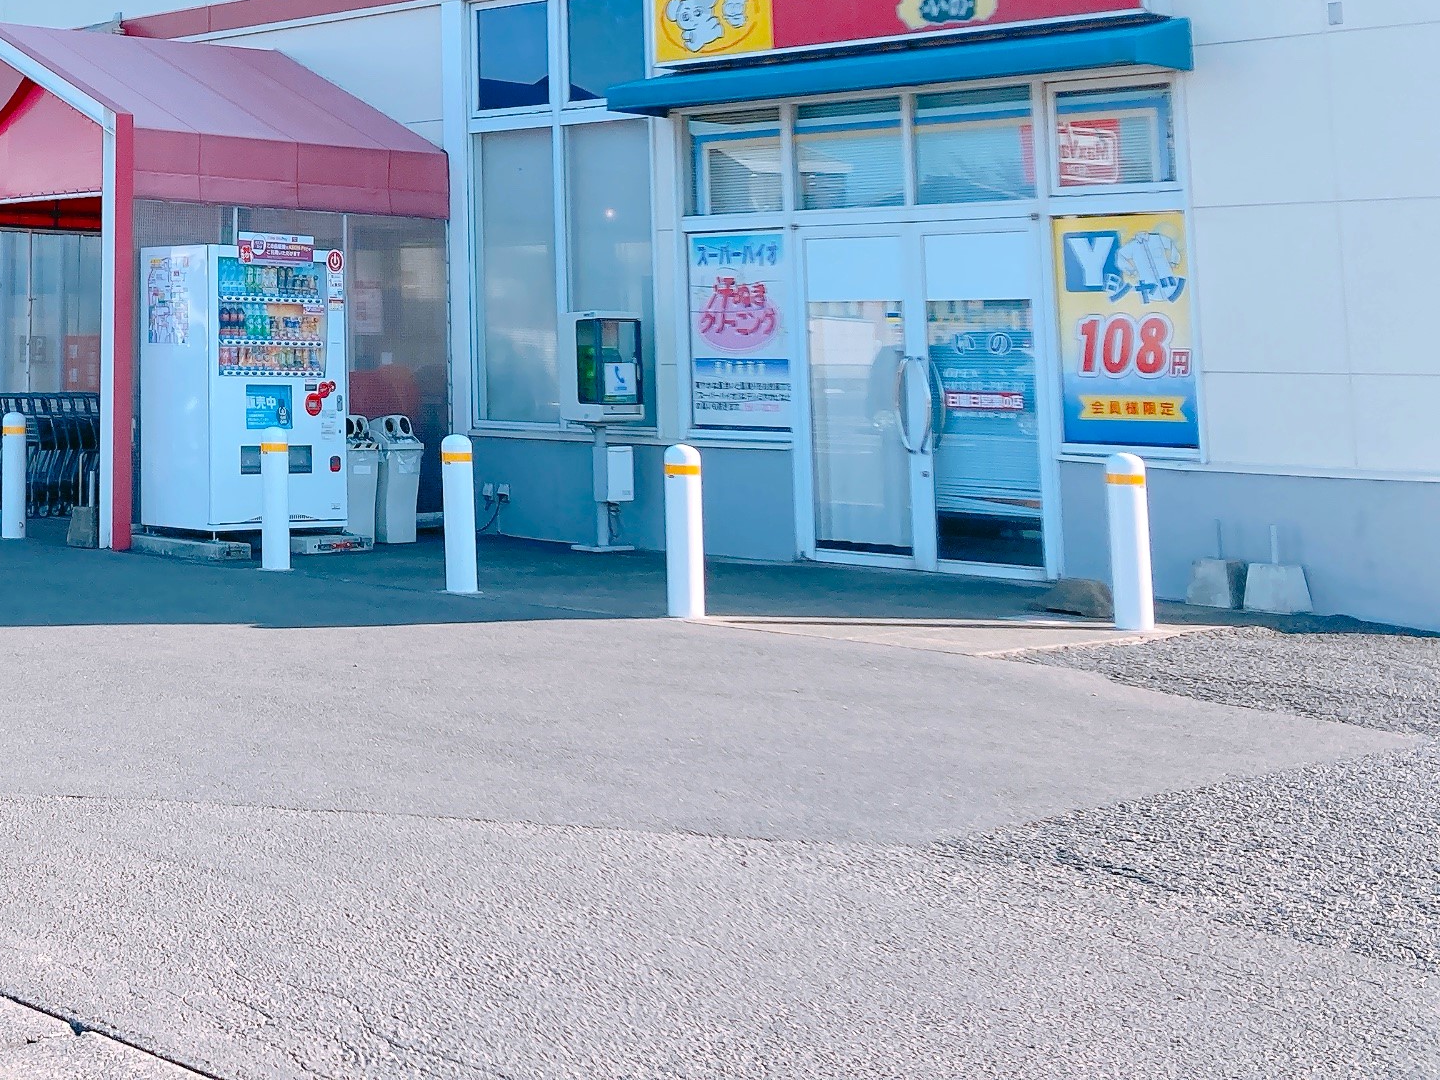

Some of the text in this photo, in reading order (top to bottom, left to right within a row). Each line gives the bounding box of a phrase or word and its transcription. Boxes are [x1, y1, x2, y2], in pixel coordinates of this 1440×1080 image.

[700, 307, 776, 336] クリーニング
[1090, 400, 1176, 416] 会員様限定
